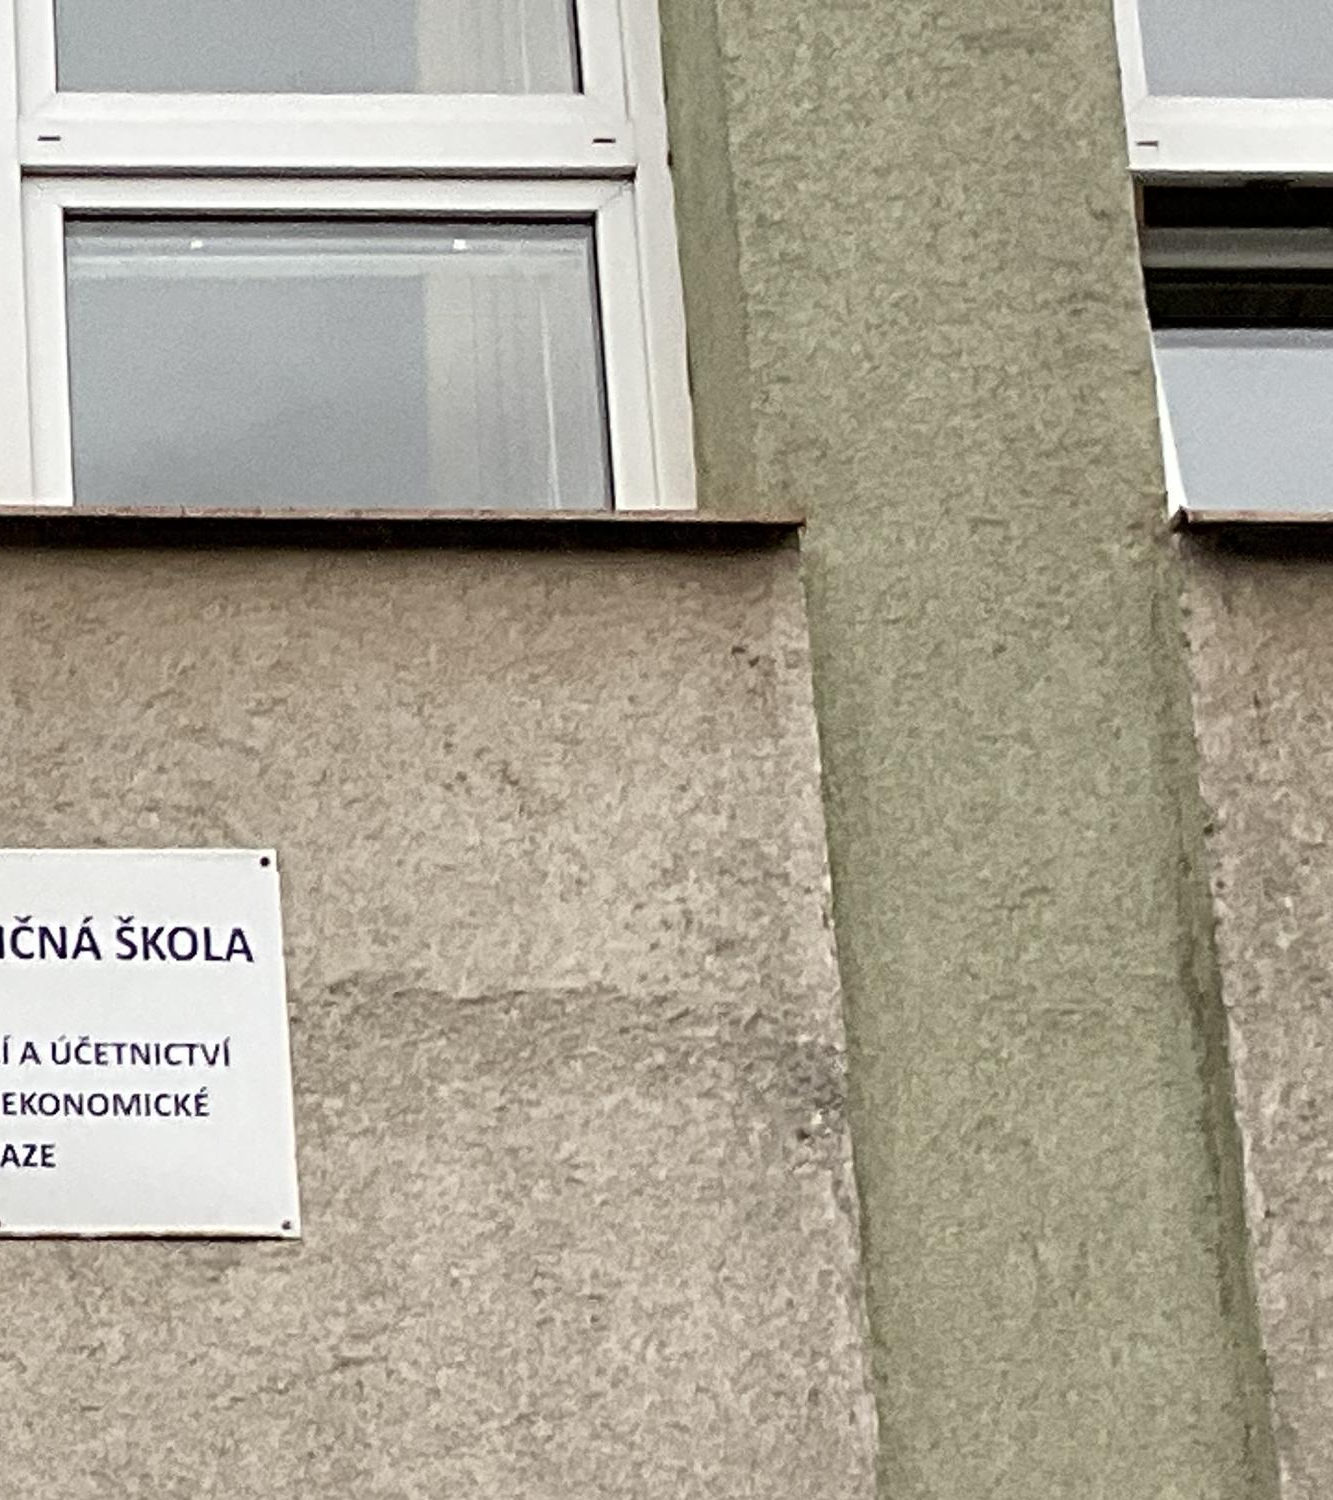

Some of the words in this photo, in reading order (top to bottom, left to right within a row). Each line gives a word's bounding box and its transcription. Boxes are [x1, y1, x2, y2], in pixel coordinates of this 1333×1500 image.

[116, 915, 254, 963] ŠKOLA
[19, 1041, 42, 1065] A
[51, 1035, 232, 1067] ÚČETNICTVÍ
[2, 1086, 210, 1117] EKONOMICKÉ
